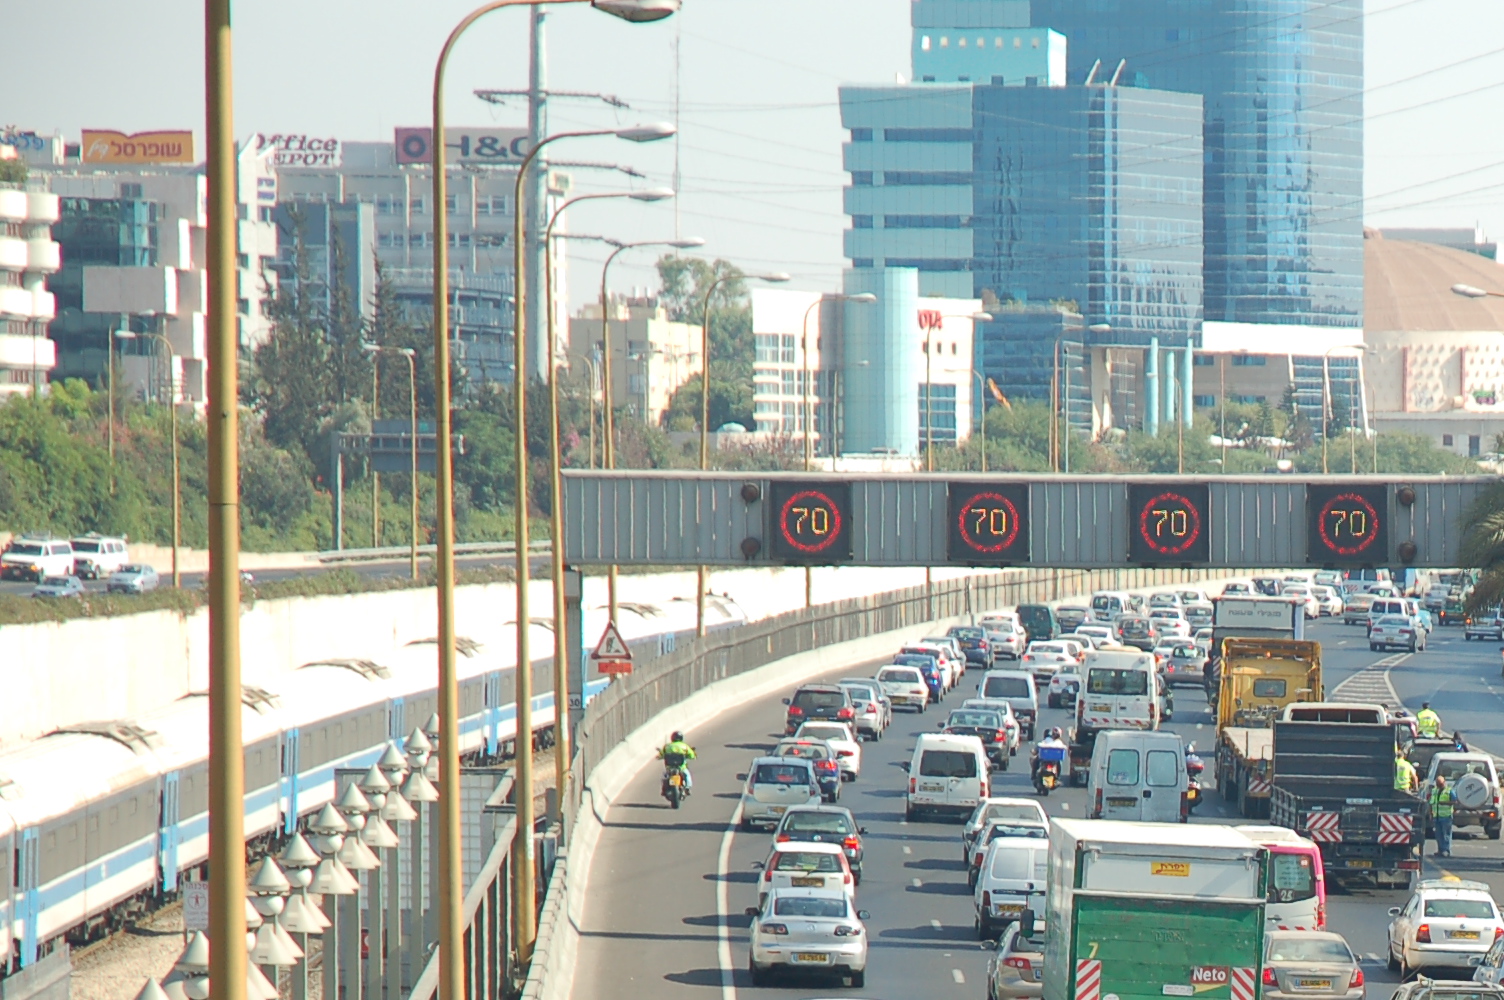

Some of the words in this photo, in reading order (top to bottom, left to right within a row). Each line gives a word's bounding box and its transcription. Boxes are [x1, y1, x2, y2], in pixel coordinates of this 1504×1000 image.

[110, 140, 183, 157] שופרסל
[273, 152, 334, 166] EPOT
[792, 507, 829, 535] 70
[971, 508, 1007, 535] 70
[1152, 510, 1187, 536] 70
[1330, 510, 1366, 537] 70
[1088, 941, 1099, 959] 7
[1193, 966, 1227, 982] Neto
